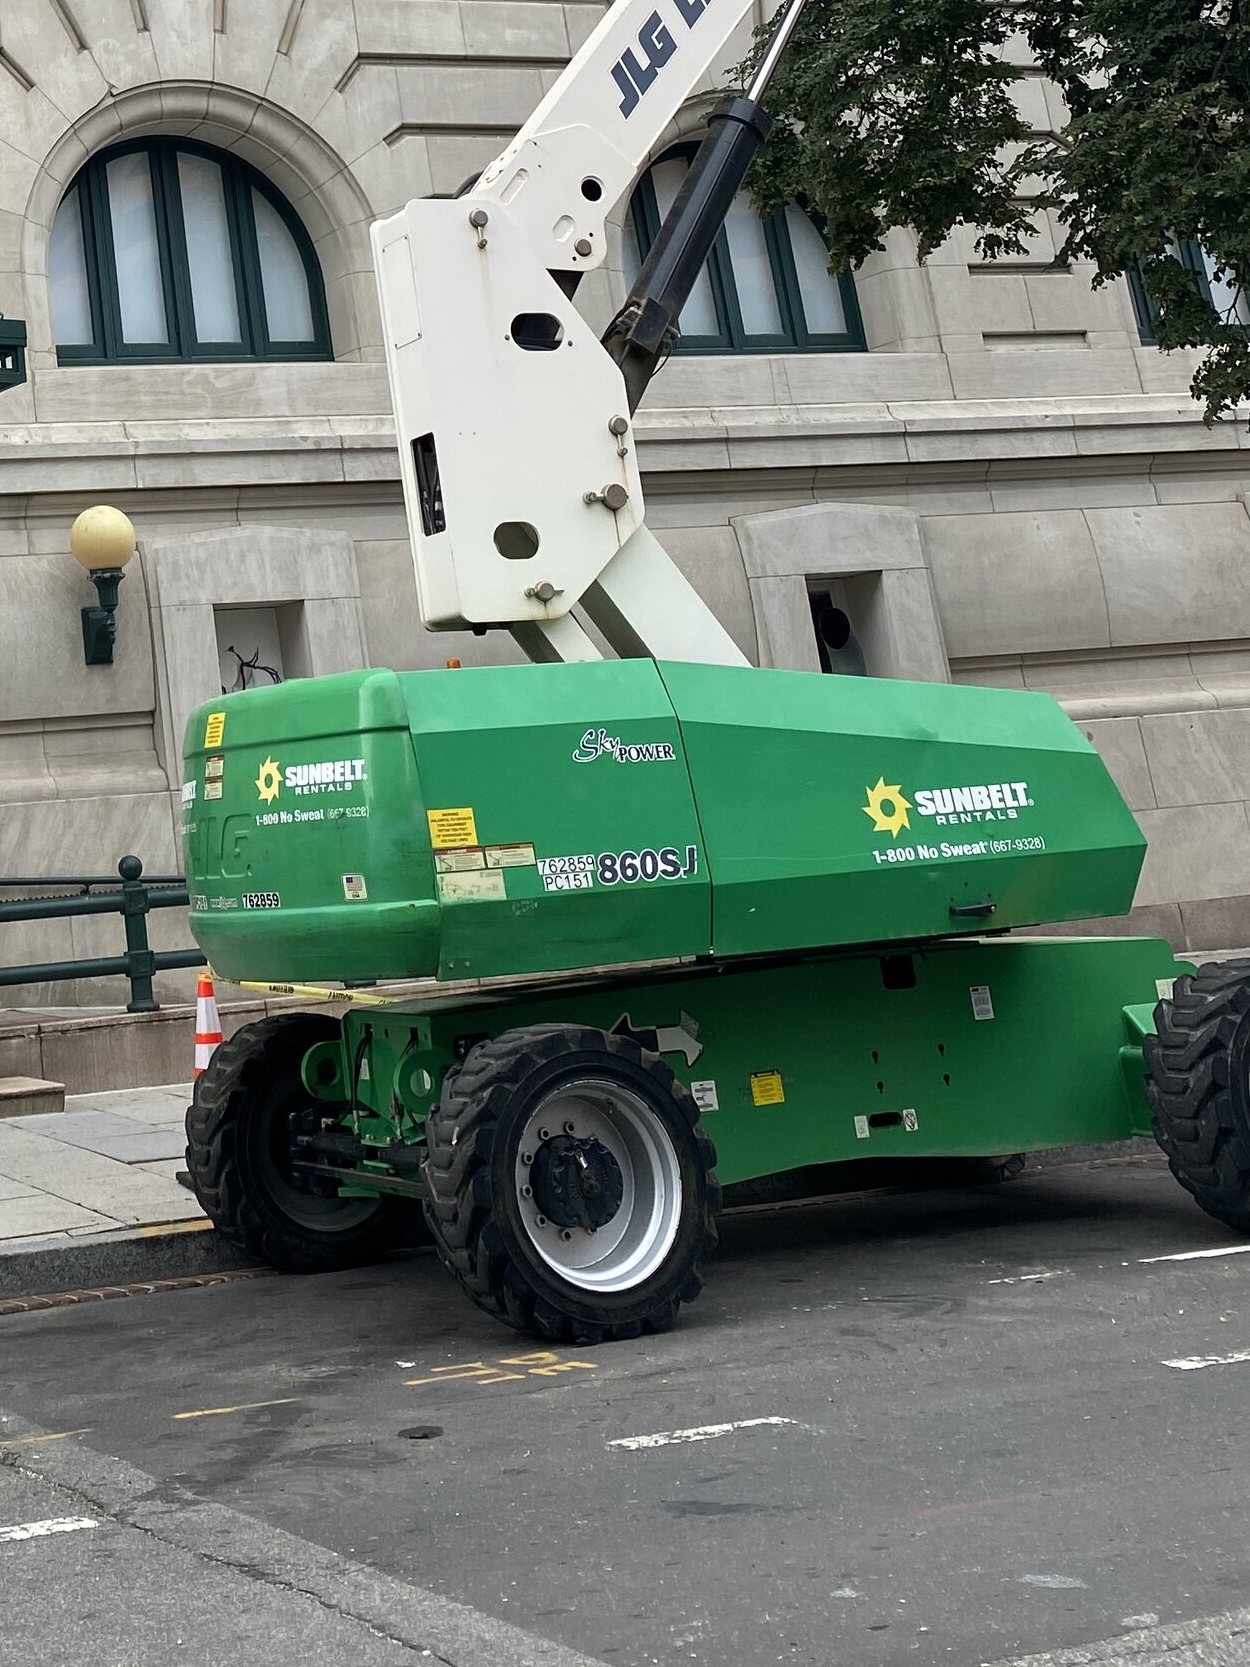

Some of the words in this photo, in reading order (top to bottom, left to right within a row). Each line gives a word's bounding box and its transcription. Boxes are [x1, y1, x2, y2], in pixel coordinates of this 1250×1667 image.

[610, 9, 678, 120] JLG
[285, 758, 366, 787] SUNBELT
[294, 781, 353, 796] RENTALS
[914, 781, 1029, 816] SUNBELT
[255, 812, 279, 826] 1-800
[280, 811, 293, 823] No
[294, 808, 325, 822] Sweat
[936, 809, 1018, 825] RENTALS
[872, 847, 915, 864] 1-800
[917, 845, 938, 859] No
[940, 840, 986, 857] Sweat
[989, 836, 1046, 854] (667-9328)
[539, 855, 595, 874] 762859
[598, 845, 697, 885] 860SJ
[545, 872, 590, 890] PC151
[243, 892, 278, 908] 762859
